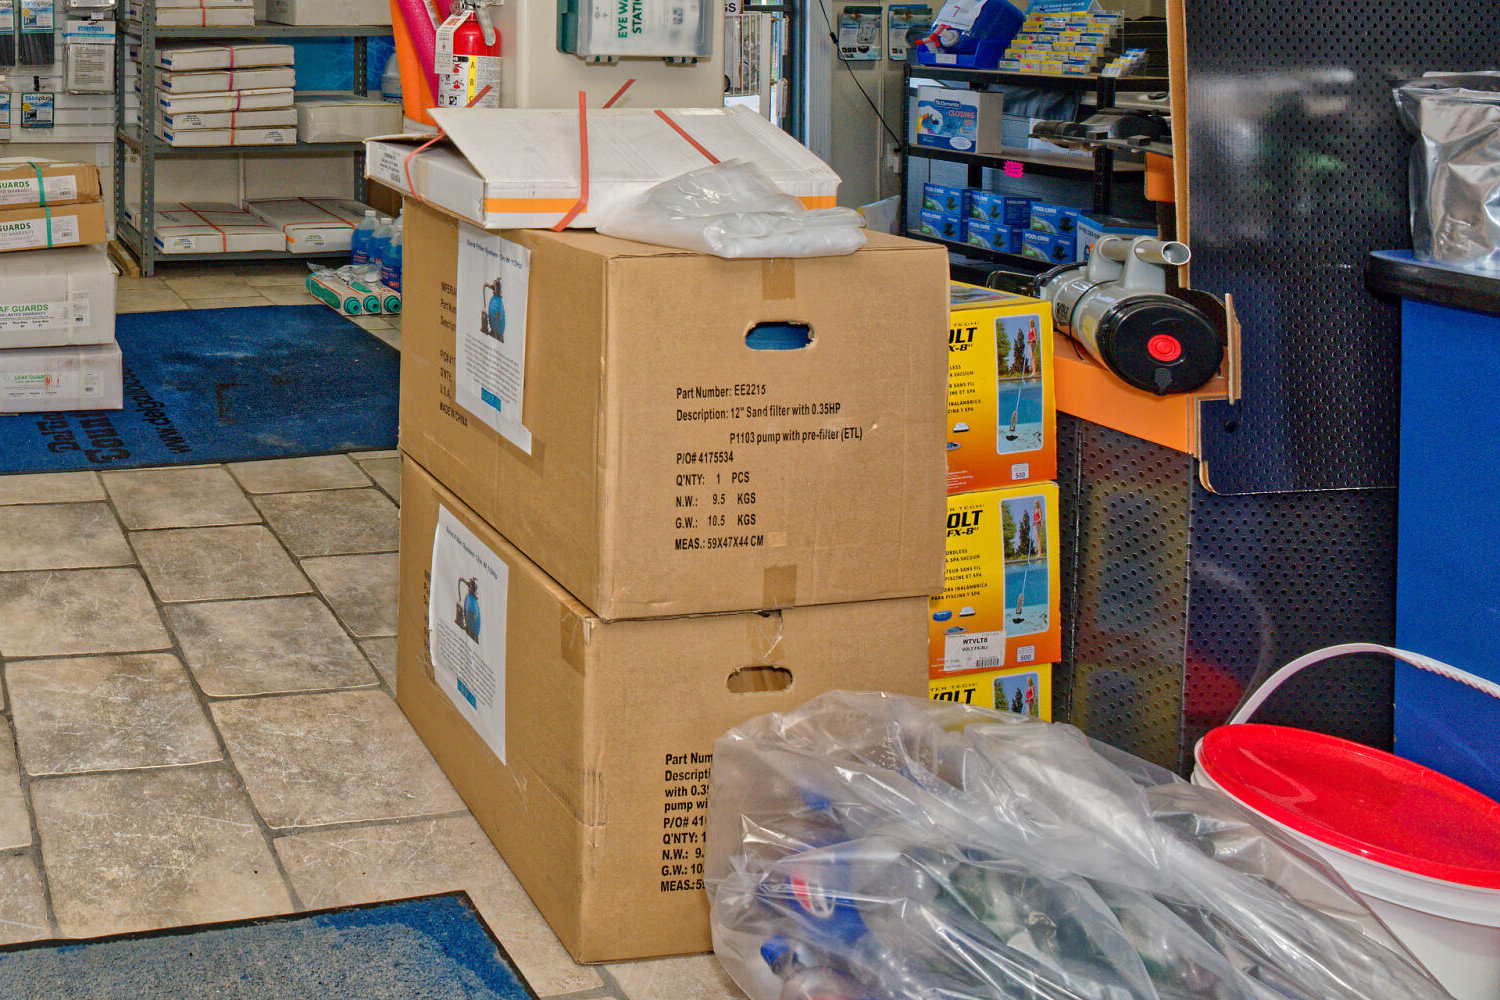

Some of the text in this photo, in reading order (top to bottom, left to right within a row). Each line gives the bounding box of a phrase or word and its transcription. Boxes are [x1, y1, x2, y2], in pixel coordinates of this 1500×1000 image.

[618, 16, 628, 38] EYE
[470, 78, 474, 86] B
[948, 110, 976, 118] CLOSING
[12, 304, 49, 312] GUARDS
[440, 298, 448, 311] Part
[676, 384, 766, 400] Part Number: EE2215
[455, 410, 468, 427] CHINA
[676, 402, 841, 422] Description: 12" Sand filter with 0.35HP
[730, 427, 863, 445] P1103 pump with pre-filter (ETL)
[676, 451, 734, 465] P/O# 4175534
[676, 472, 750, 487] Q'NTY: 1 PCS
[676, 492, 756, 508] N.W.: 9.5 KGS
[676, 514, 756, 529] G.W.: 10.5 KGS
[675, 536, 764, 550] MEAS.: 59X47X44 CM
[666, 752, 713, 765] Part Num
[665, 786, 688, 798] with
[664, 800, 708, 814] pump wi
[664, 817, 689, 829] P/O#
[663, 831, 706, 845] Q'NTY: 1
[662, 849, 688, 860] N.W.:
[661, 865, 687, 877] G.W.:
[660, 880, 694, 892] MEAS.:
